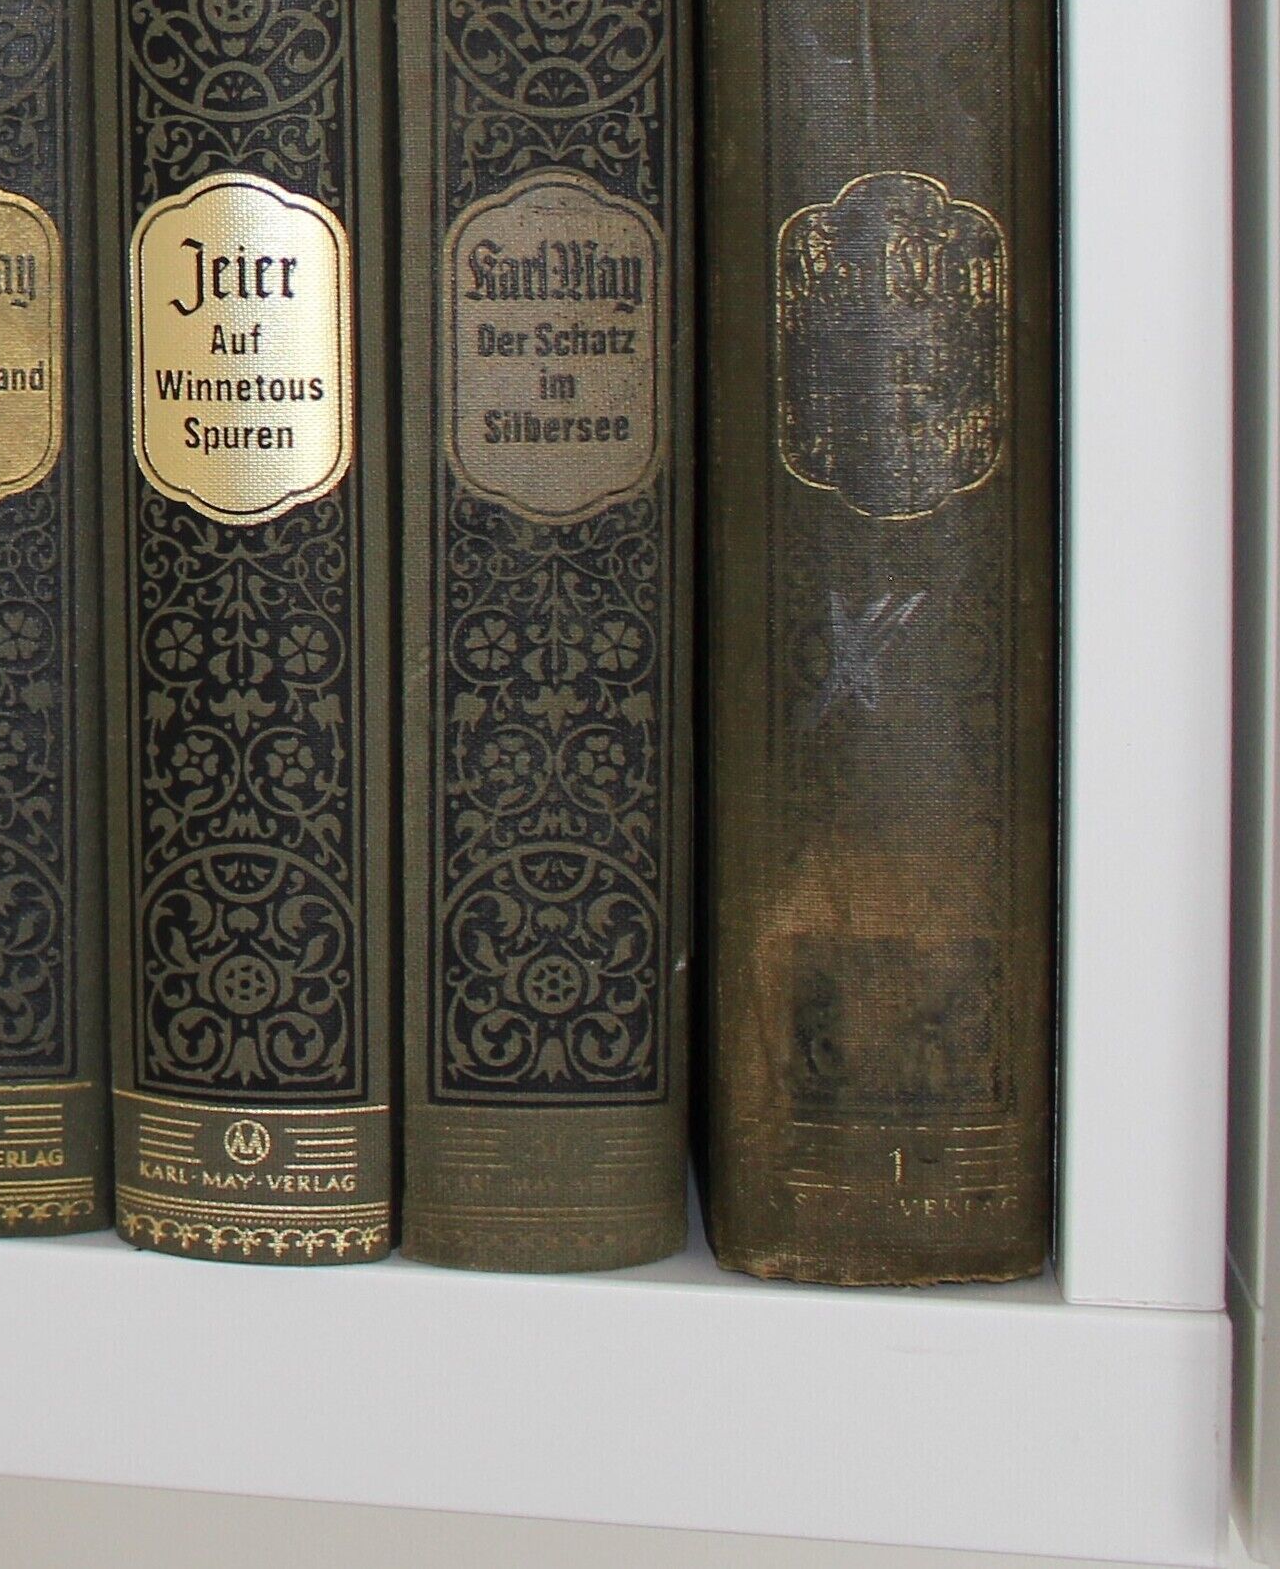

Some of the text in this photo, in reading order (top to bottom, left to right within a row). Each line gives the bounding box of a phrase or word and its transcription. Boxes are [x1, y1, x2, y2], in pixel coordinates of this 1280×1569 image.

[169, 236, 299, 317] Jeier
[463, 237, 642, 315] Karl May
[209, 322, 262, 357] Auf
[476, 321, 637, 358] Der Schatz
[155, 368, 325, 403] Winnetous
[539, 366, 577, 400] im
[183, 416, 294, 455] Spuren
[482, 409, 630, 445] Silbersee
